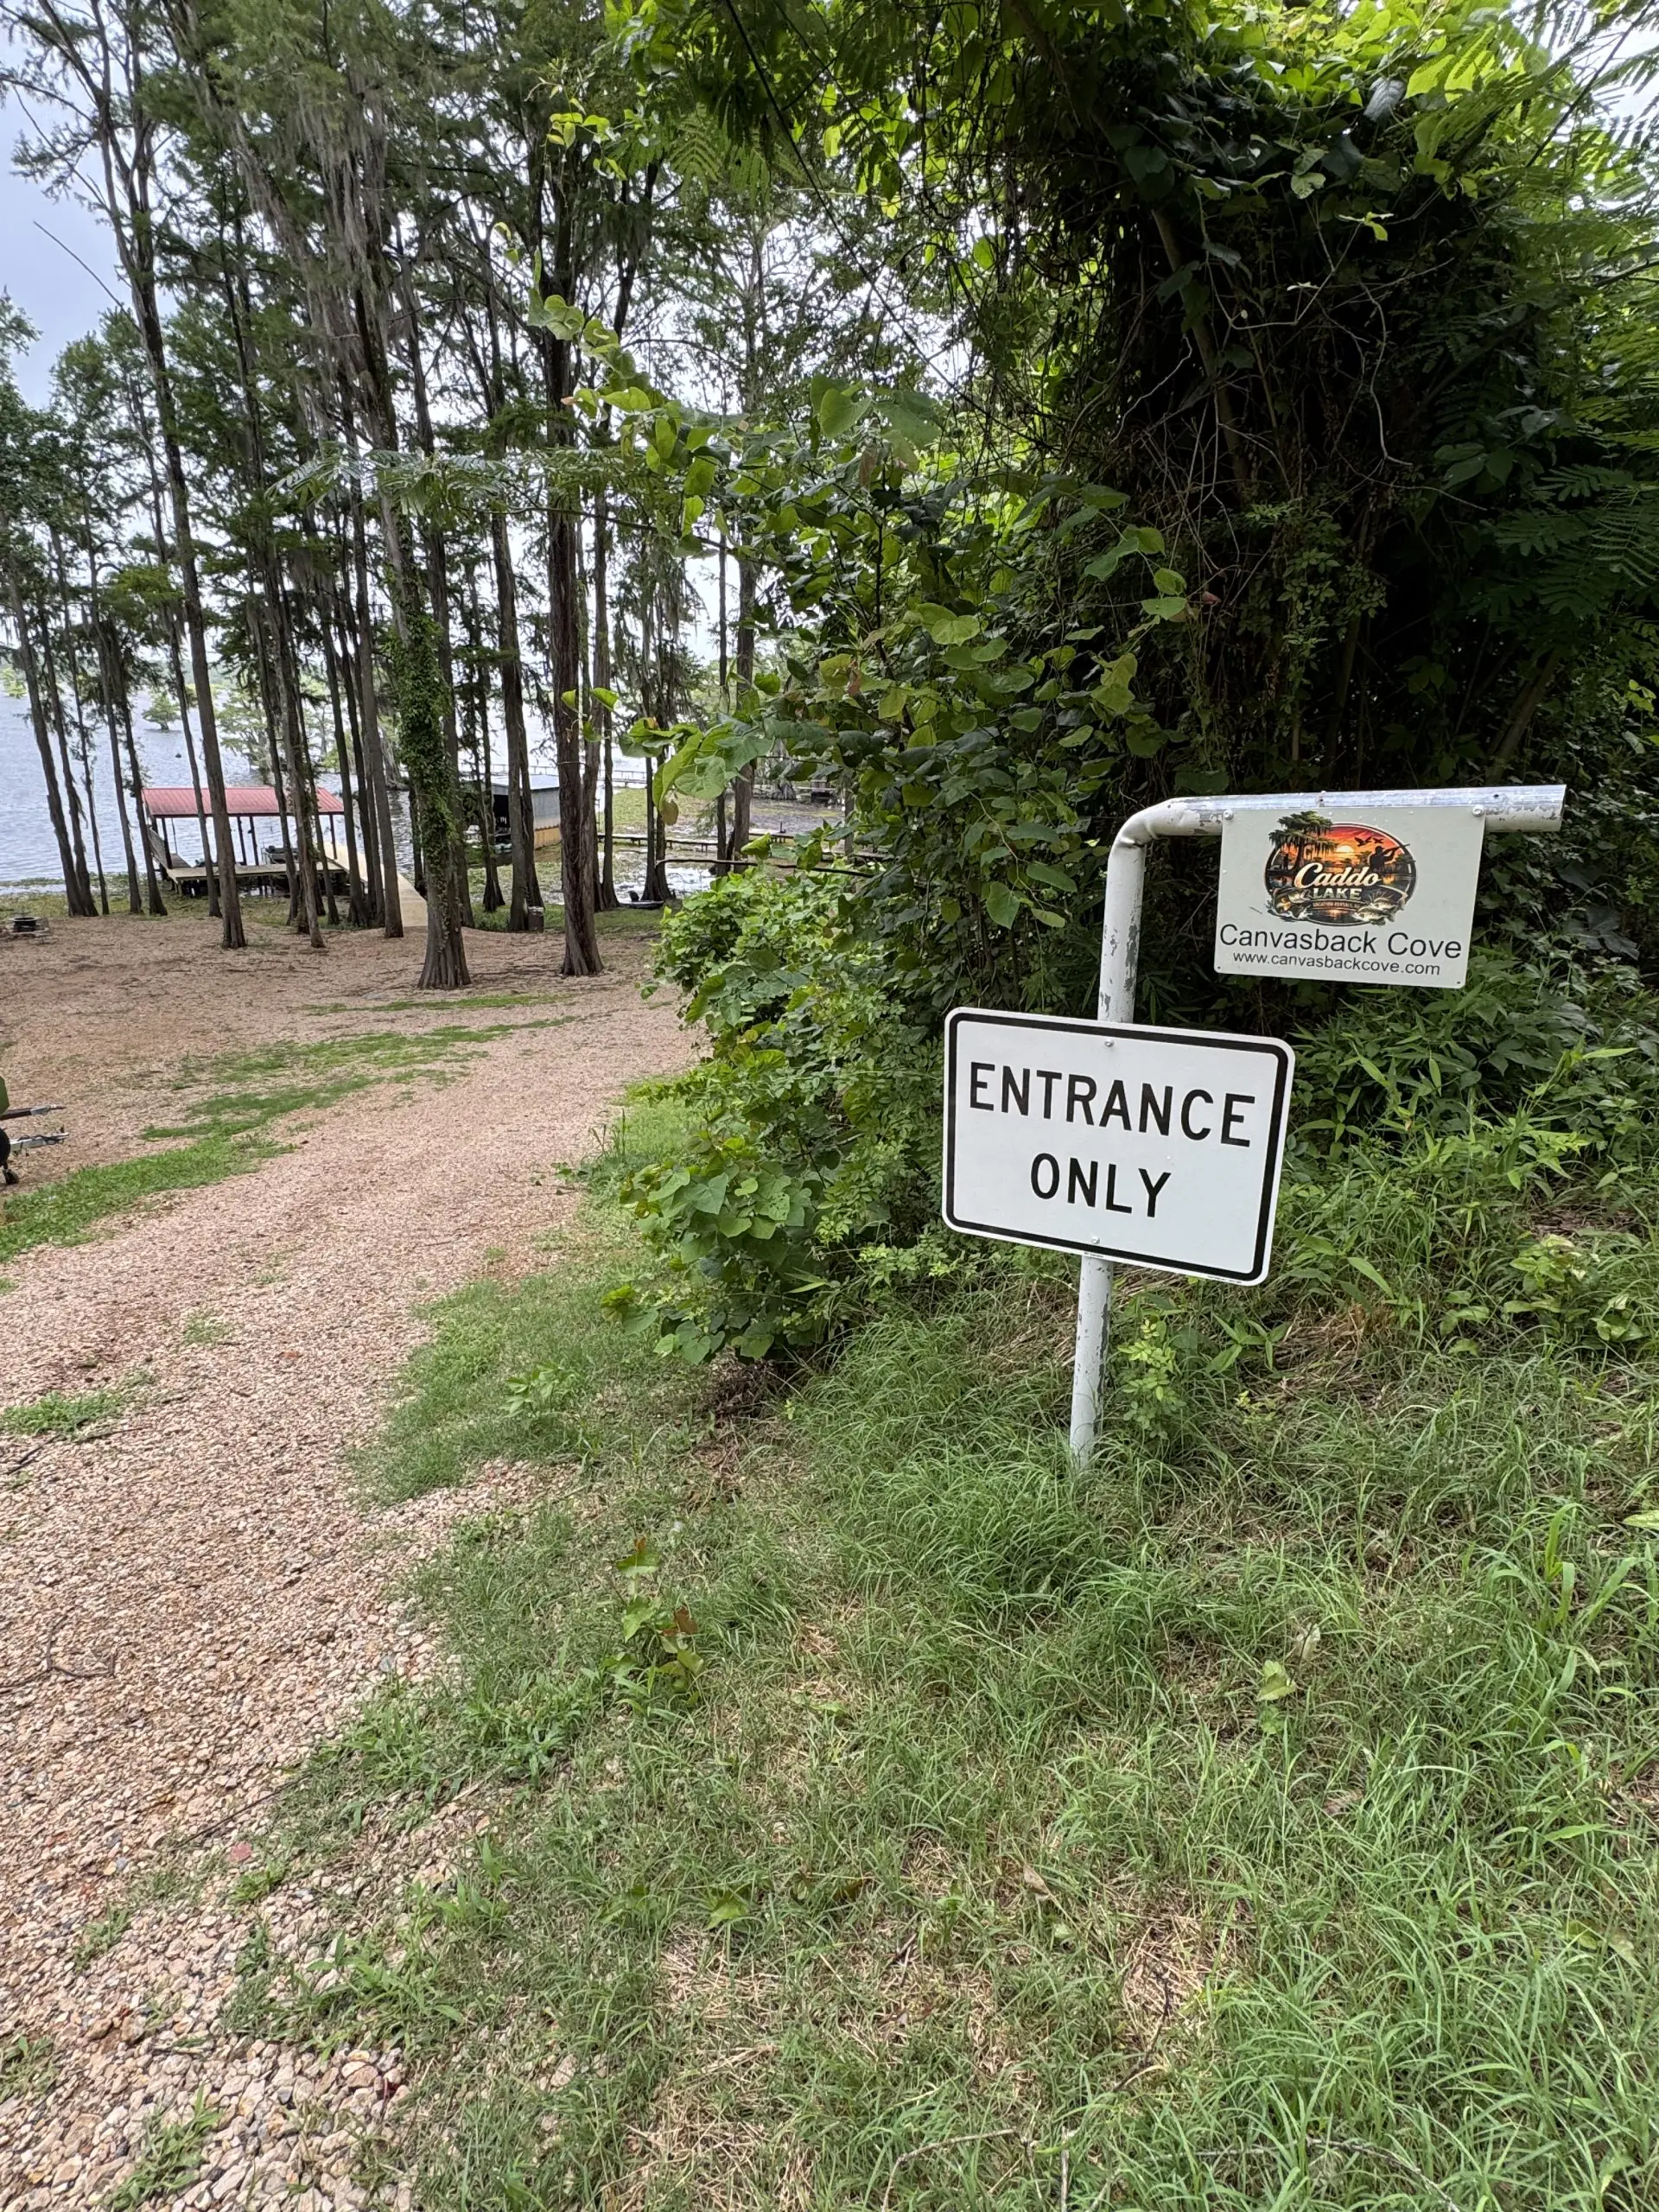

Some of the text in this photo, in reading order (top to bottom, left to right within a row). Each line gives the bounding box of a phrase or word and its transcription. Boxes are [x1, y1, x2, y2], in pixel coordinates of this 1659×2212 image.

[1294, 862, 1382, 889] Caddo
[1313, 887, 1363, 900] LAKE
[1220, 924, 1462, 958] Canvasback Cove
[1233, 952, 1440, 975] www.canvasbackcove.com
[970, 1062, 1255, 1147] ENTRANCE
[1031, 1153, 1172, 1217] ONLY
